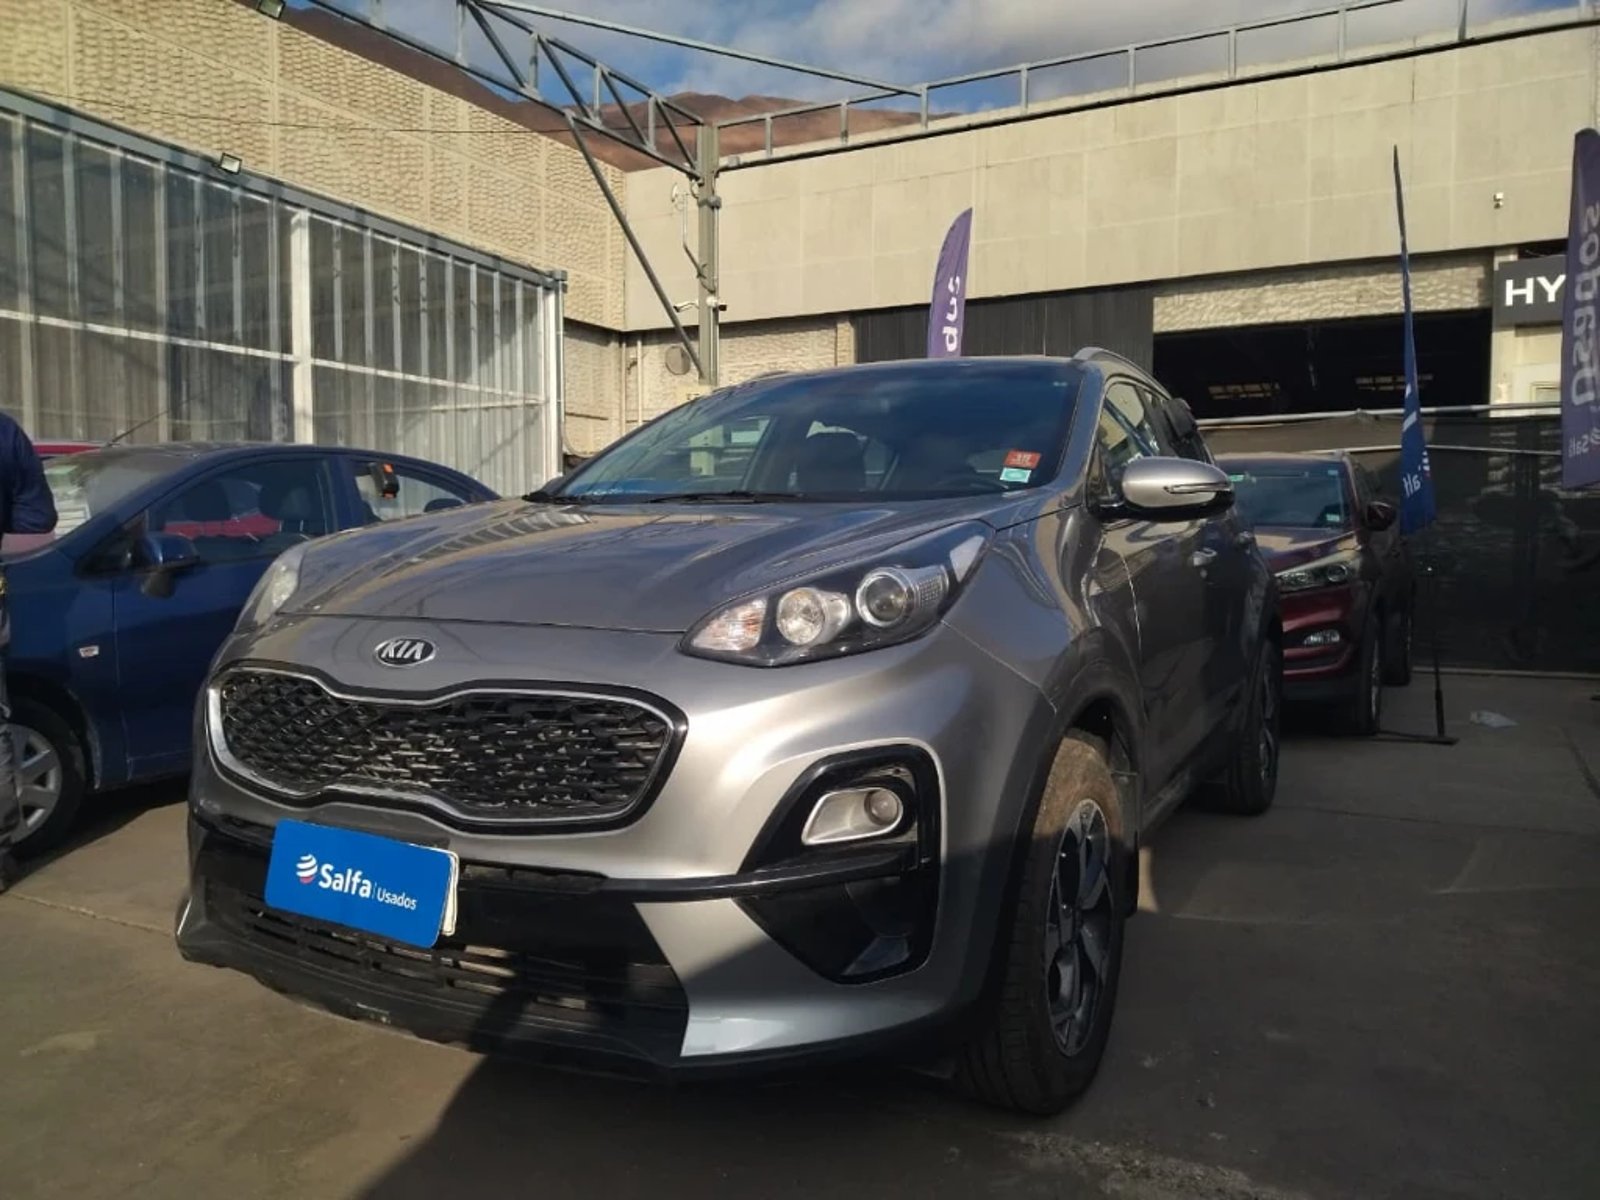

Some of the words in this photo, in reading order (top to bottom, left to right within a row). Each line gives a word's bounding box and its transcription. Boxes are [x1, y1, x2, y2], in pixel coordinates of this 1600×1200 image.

[381, 640, 425, 660] KIA
[318, 863, 372, 899] Salfa
[377, 886, 418, 911] Usados
